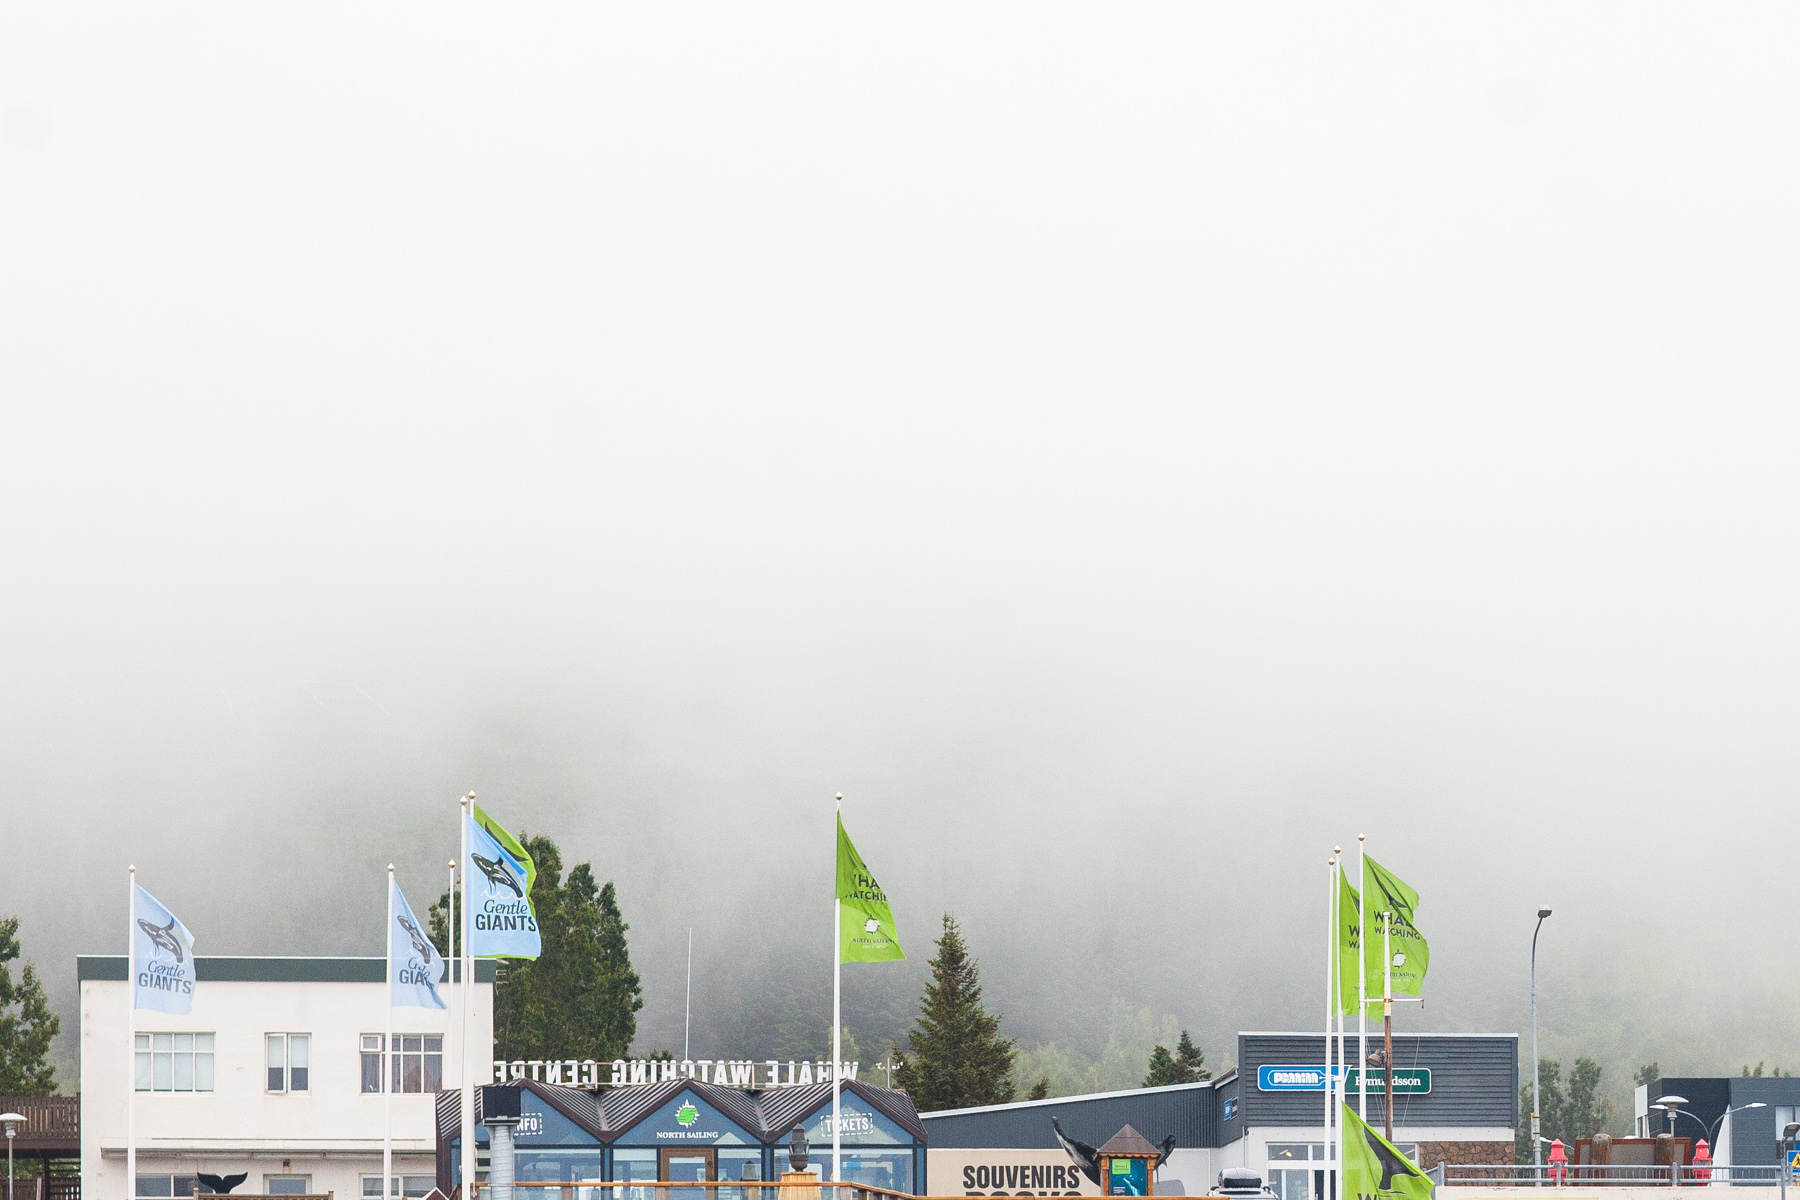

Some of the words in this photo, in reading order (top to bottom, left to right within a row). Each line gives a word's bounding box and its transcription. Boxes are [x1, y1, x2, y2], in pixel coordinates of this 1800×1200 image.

[484, 899, 528, 914] Gentle
[475, 913, 536, 932] GIANTS
[1374, 926, 1421, 940] WCHING
[148, 960, 185, 978] Gentle
[138, 972, 192, 994] GIANTS
[1355, 1075, 1422, 1086] Emudsson
[516, 1117, 538, 1131] NFO
[824, 1117, 869, 1132] TCKETS
[656, 1131, 686, 1139] NORTH
[687, 1131, 719, 1139] SAILING
[963, 1165, 1080, 1190] SOUVENIRS
